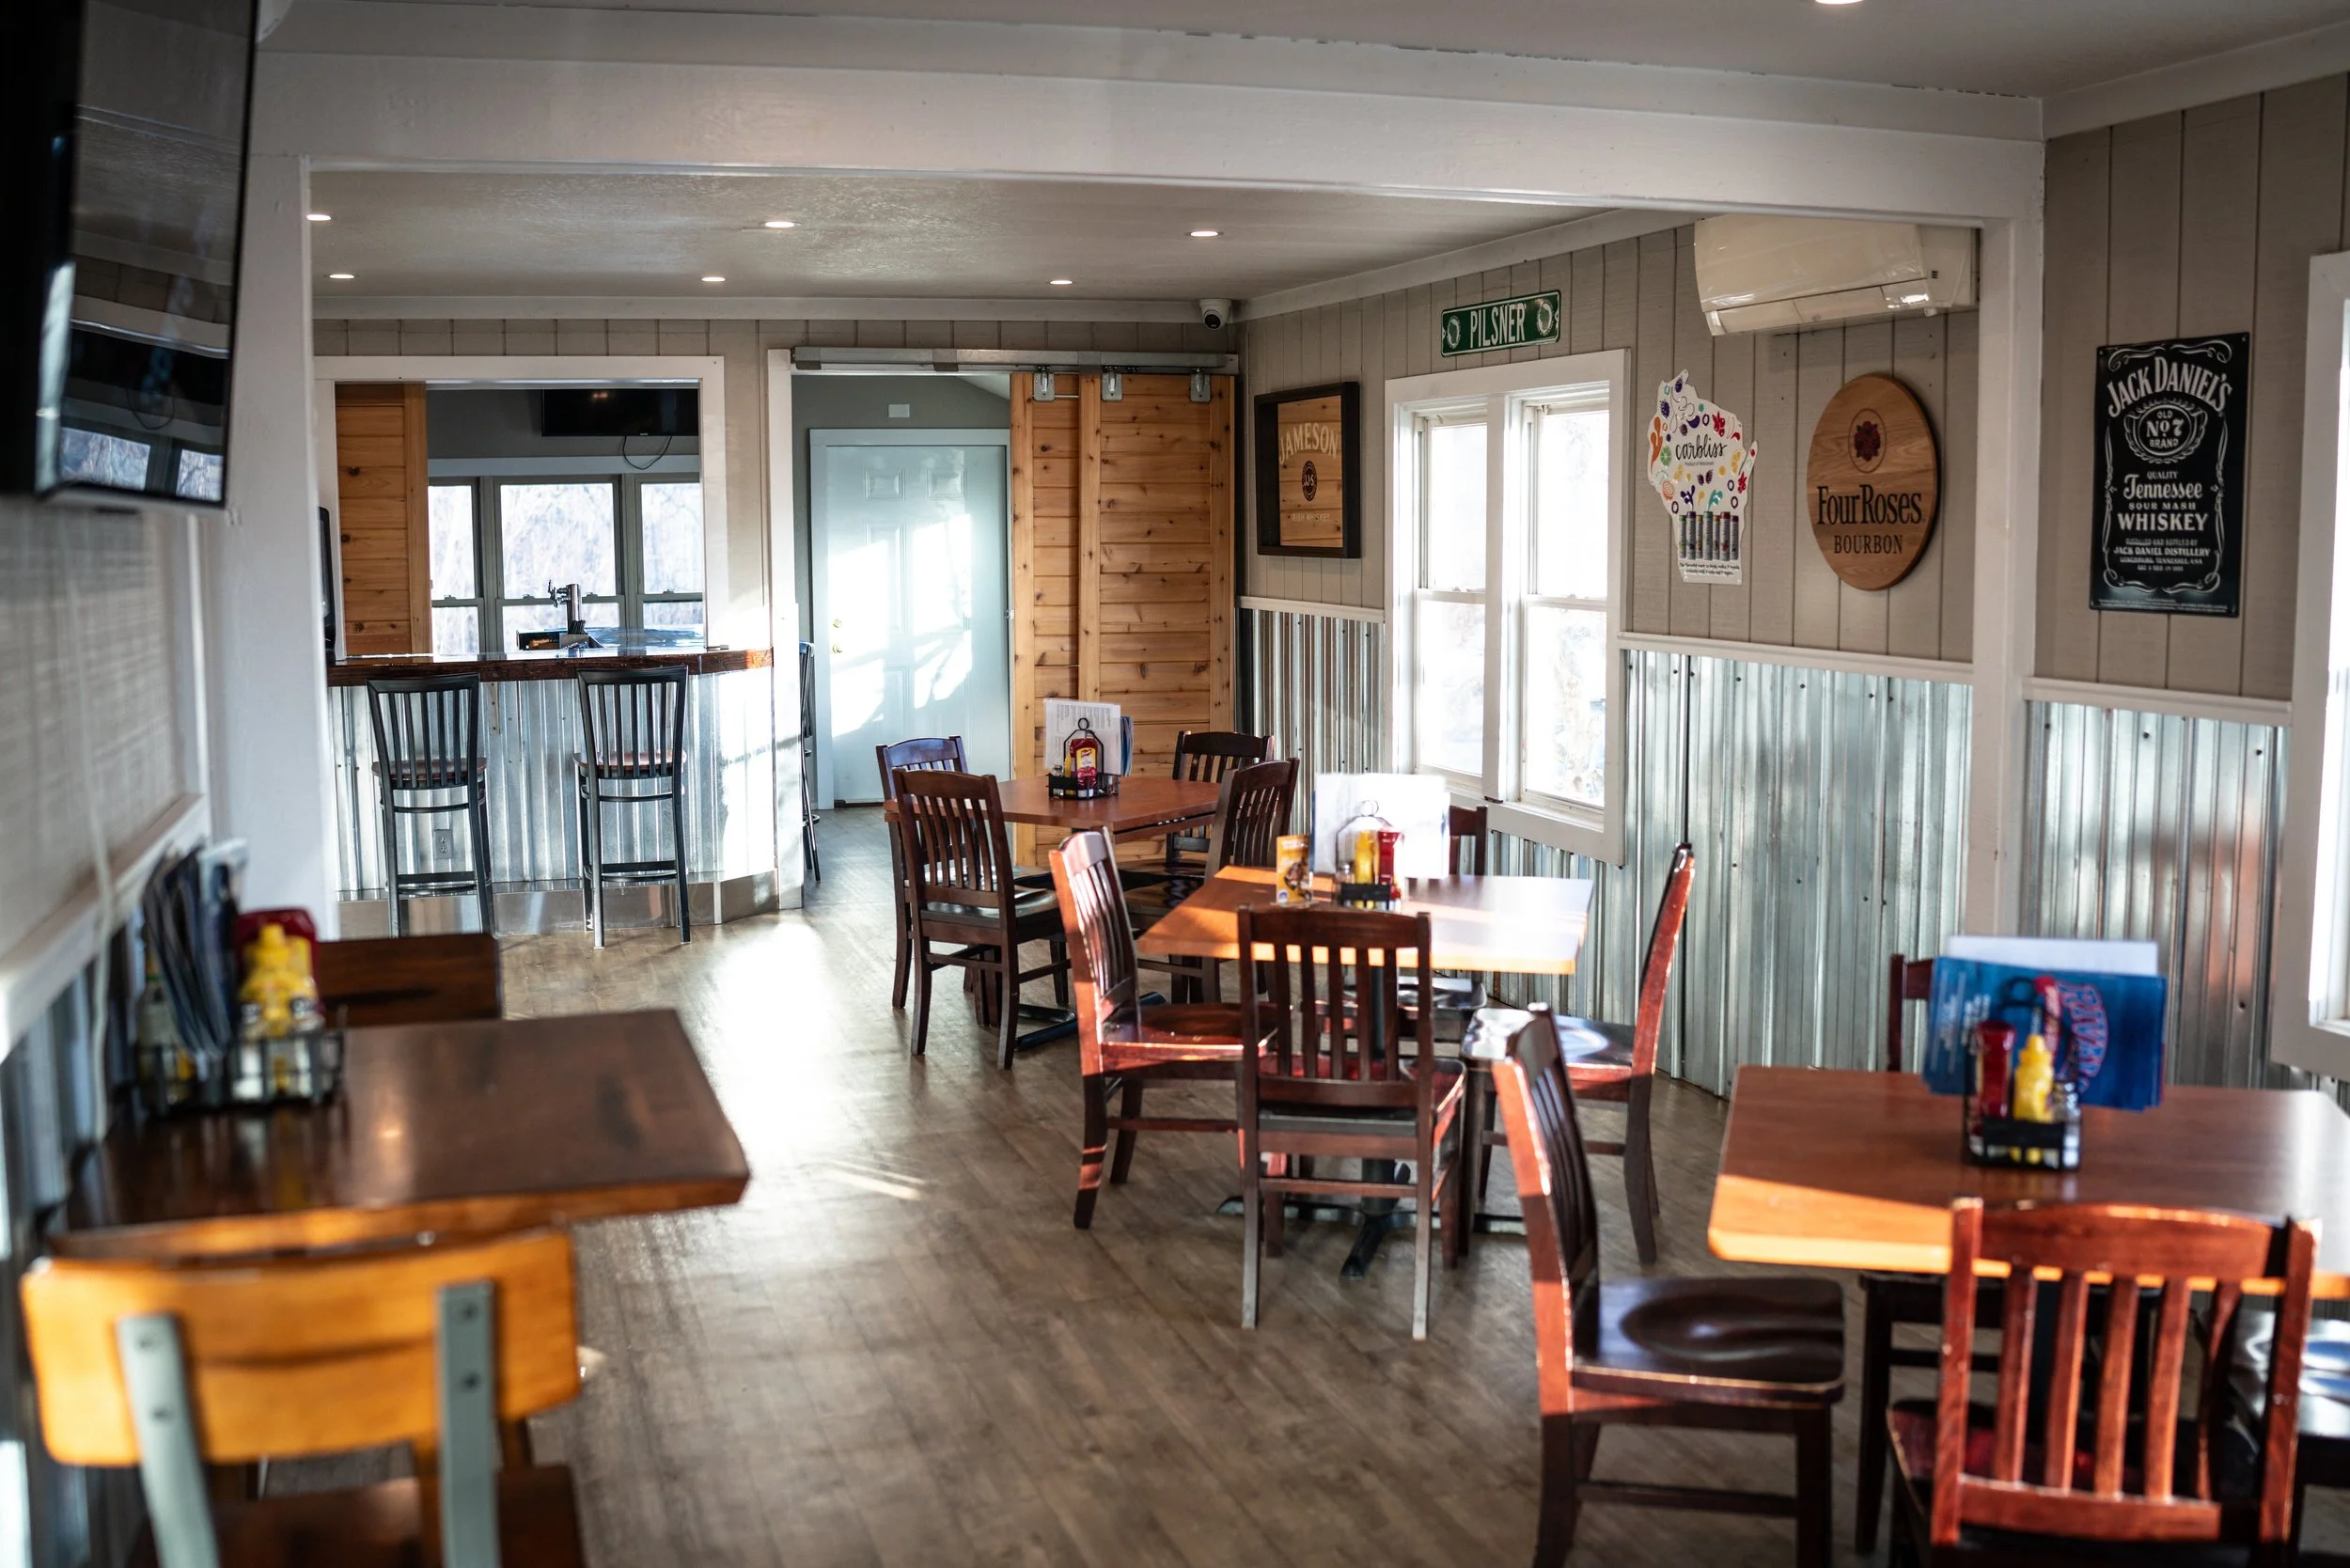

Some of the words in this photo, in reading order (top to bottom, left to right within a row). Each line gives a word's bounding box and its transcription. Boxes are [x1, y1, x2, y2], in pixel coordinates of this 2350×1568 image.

[1470, 303, 1526, 349] PILSNER
[2107, 366, 2154, 417] JACK
[2154, 356, 2232, 412] DANIEL'S
[2156, 410, 2173, 419] OLD
[2172, 418, 2185, 436] 7
[1279, 422, 1340, 464] JAMESON
[1675, 433, 1728, 461] carbliss
[2149, 438, 2179, 448] BRAND
[2146, 471, 2179, 479] QUALITY
[2123, 474, 2203, 499] Tennessee
[1817, 485, 1859, 525] Four
[1859, 484, 1922, 525] Roses
[2128, 502, 2158, 510] SOUR
[2162, 502, 2197, 510] MASH
[2117, 512, 2209, 531] WHISKEY
[1833, 535, 1904, 555] BOURBON
